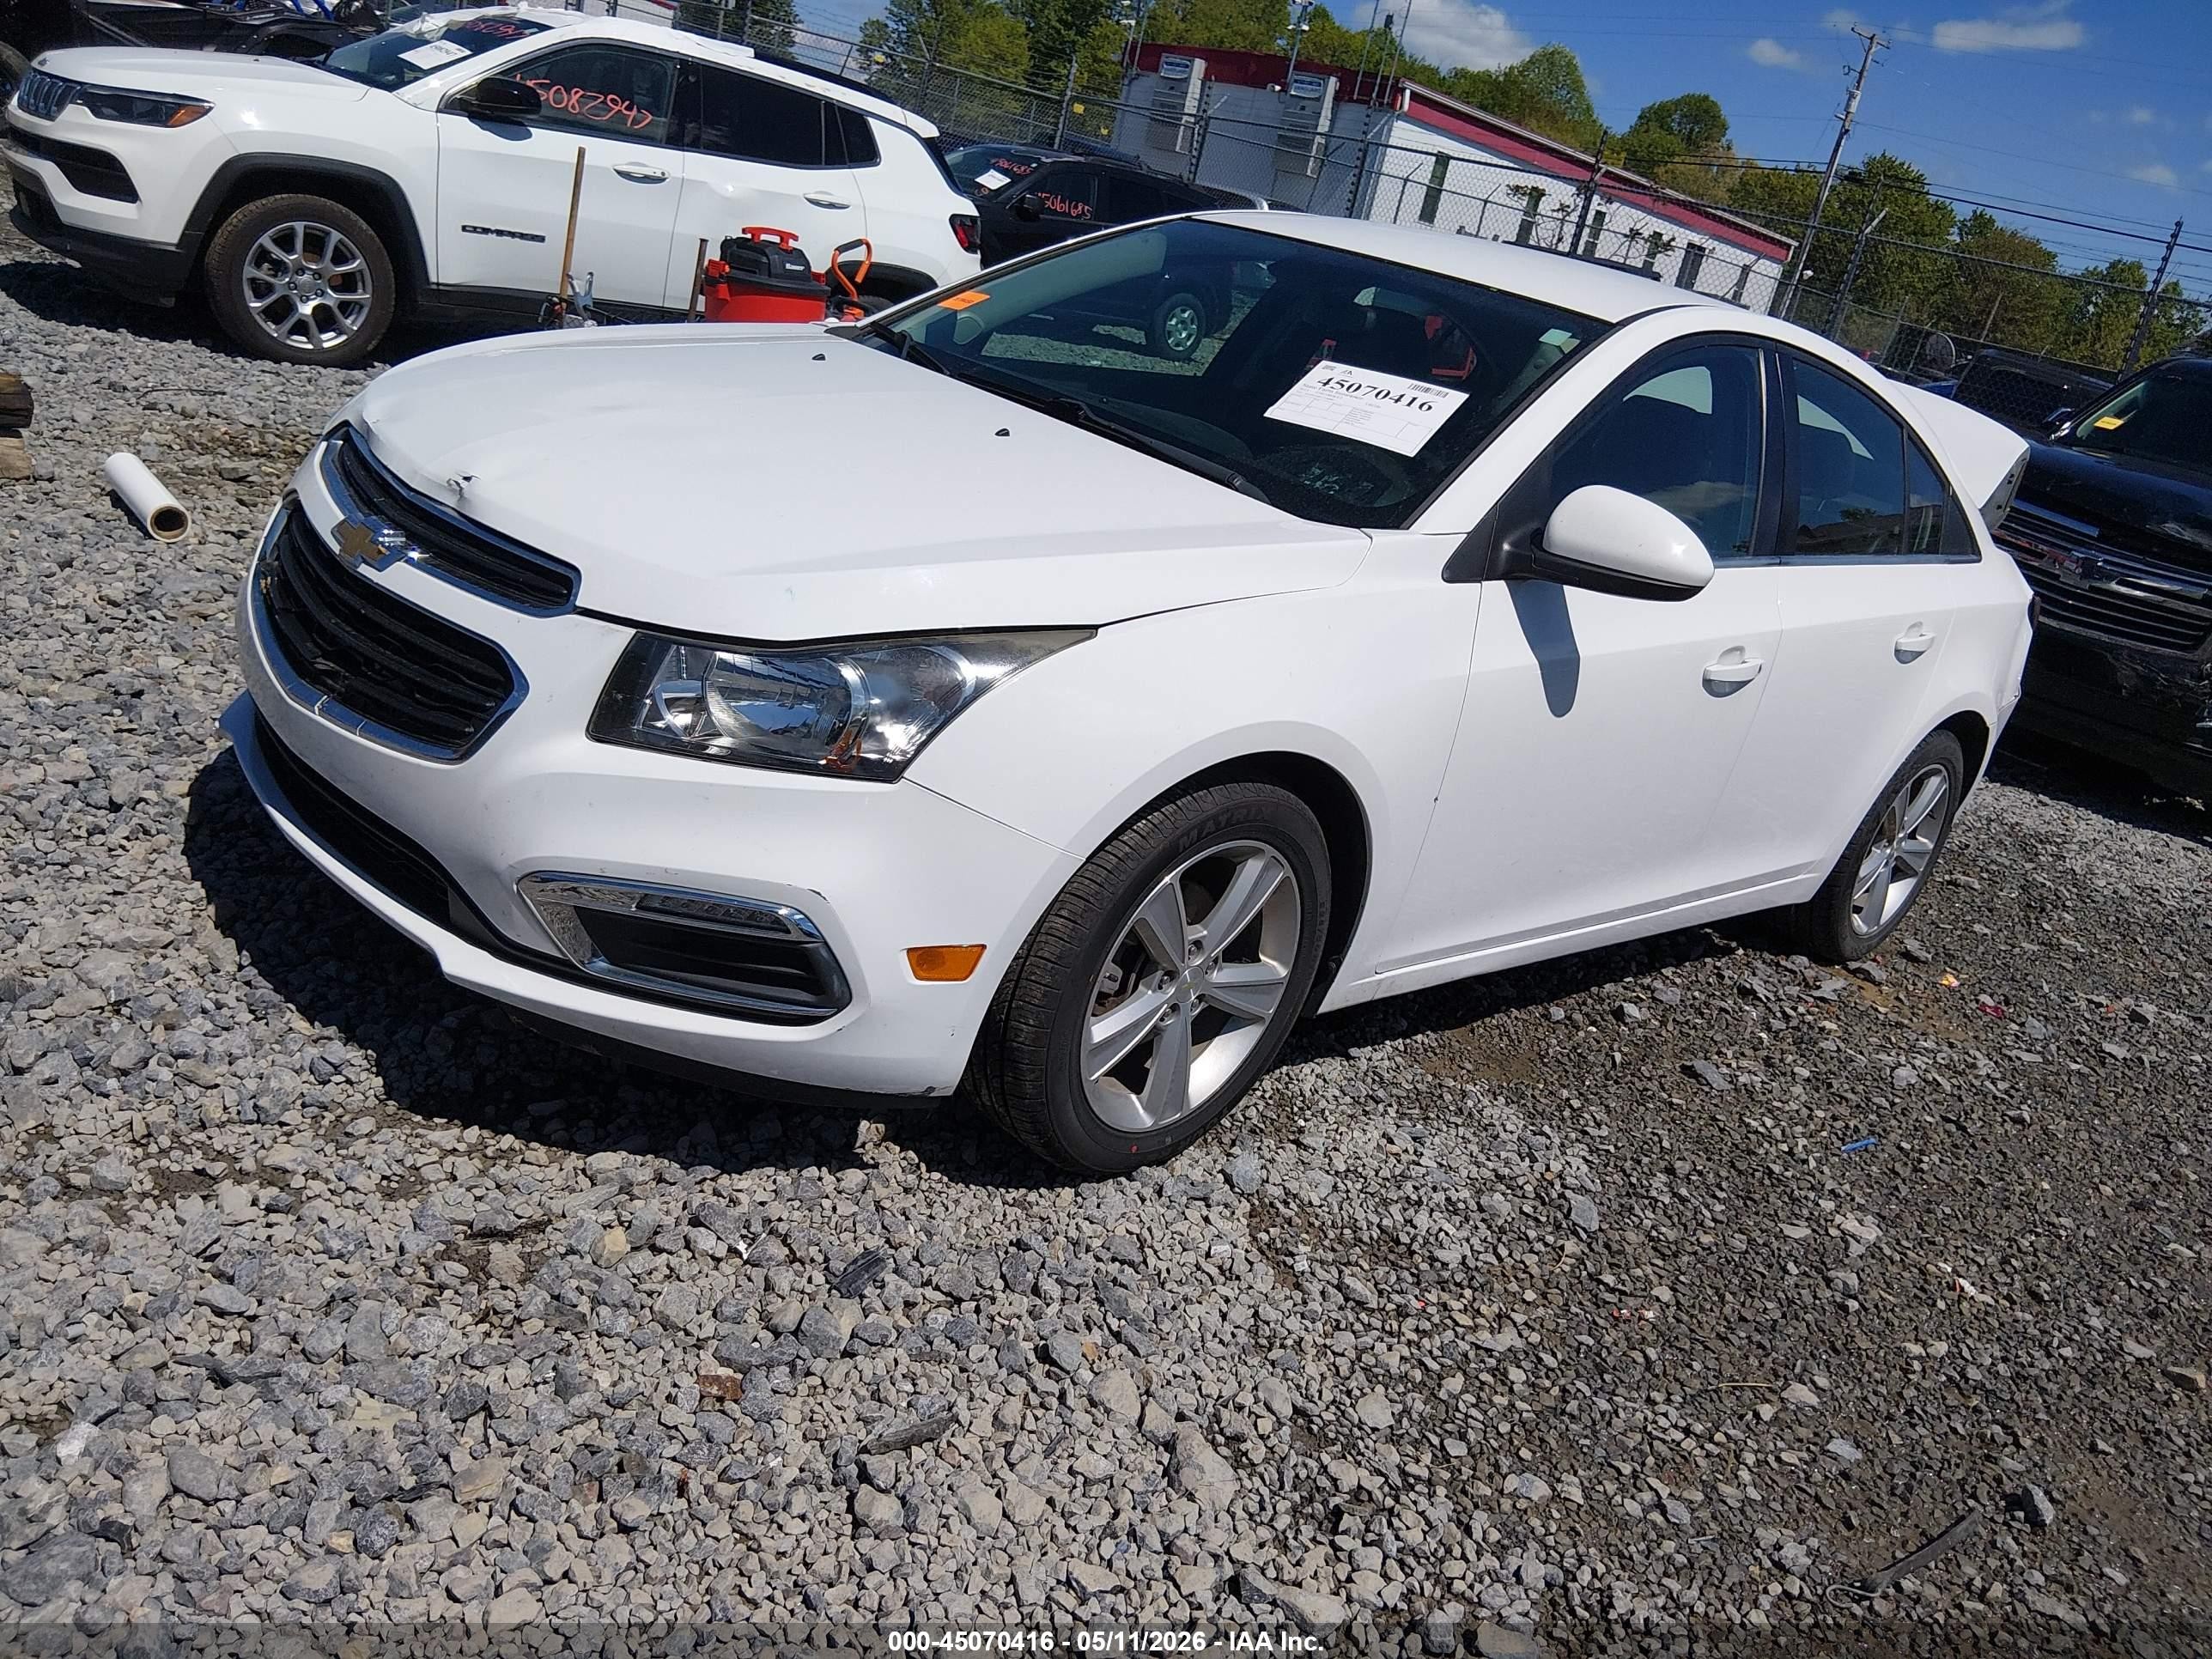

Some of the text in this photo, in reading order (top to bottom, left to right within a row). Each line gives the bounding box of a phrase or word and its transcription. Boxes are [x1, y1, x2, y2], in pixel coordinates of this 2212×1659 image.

[516, 74, 653, 129] 5082947
[1035, 192, 1093, 219] 5061685
[1317, 377, 1435, 412] 45070416
